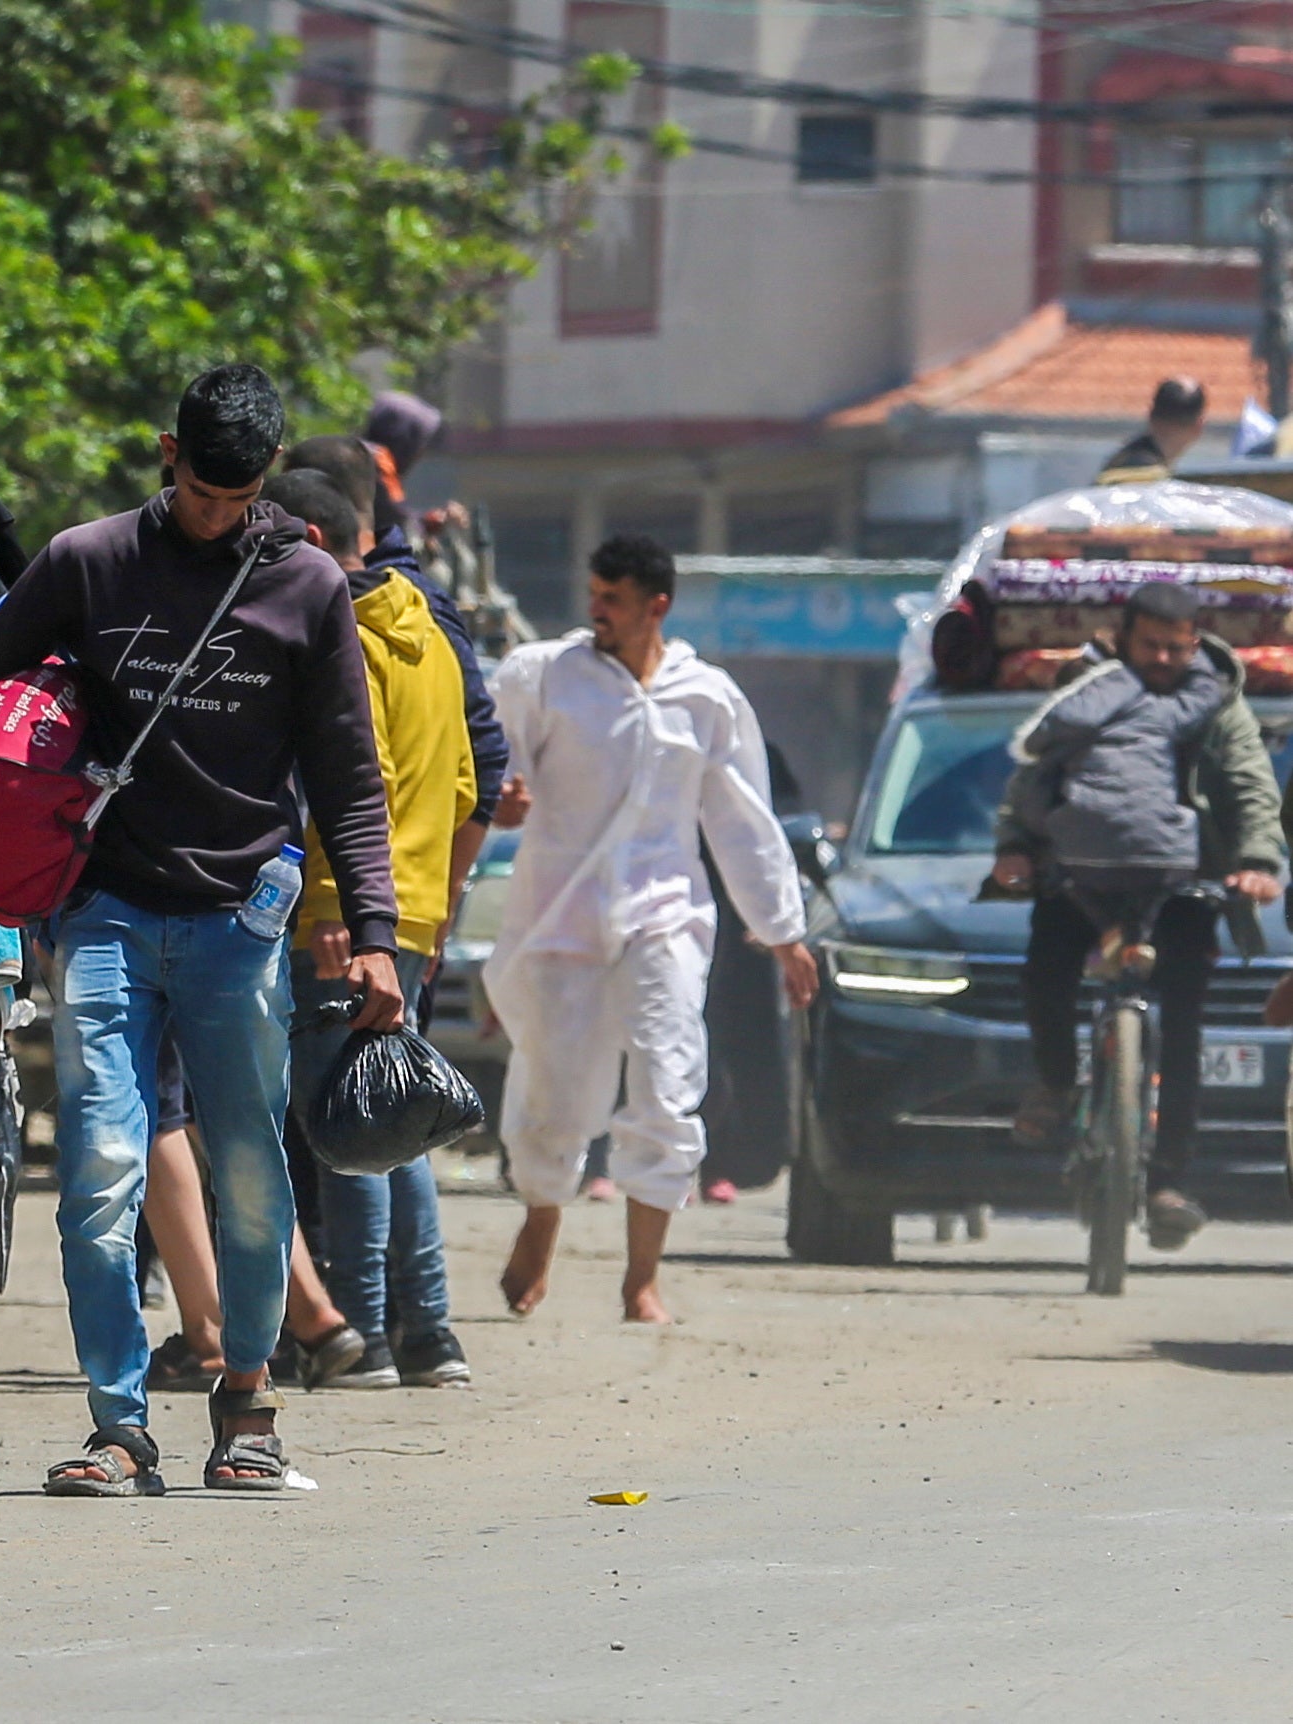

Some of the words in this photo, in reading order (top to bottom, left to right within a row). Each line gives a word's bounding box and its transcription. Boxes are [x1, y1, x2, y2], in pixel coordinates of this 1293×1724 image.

[99, 614, 200, 682] Talented
[190, 629, 273, 695] Society
[128, 688, 154, 701] KNEW
[227, 701, 241, 713] UP
[2, 707, 29, 733] Peace
